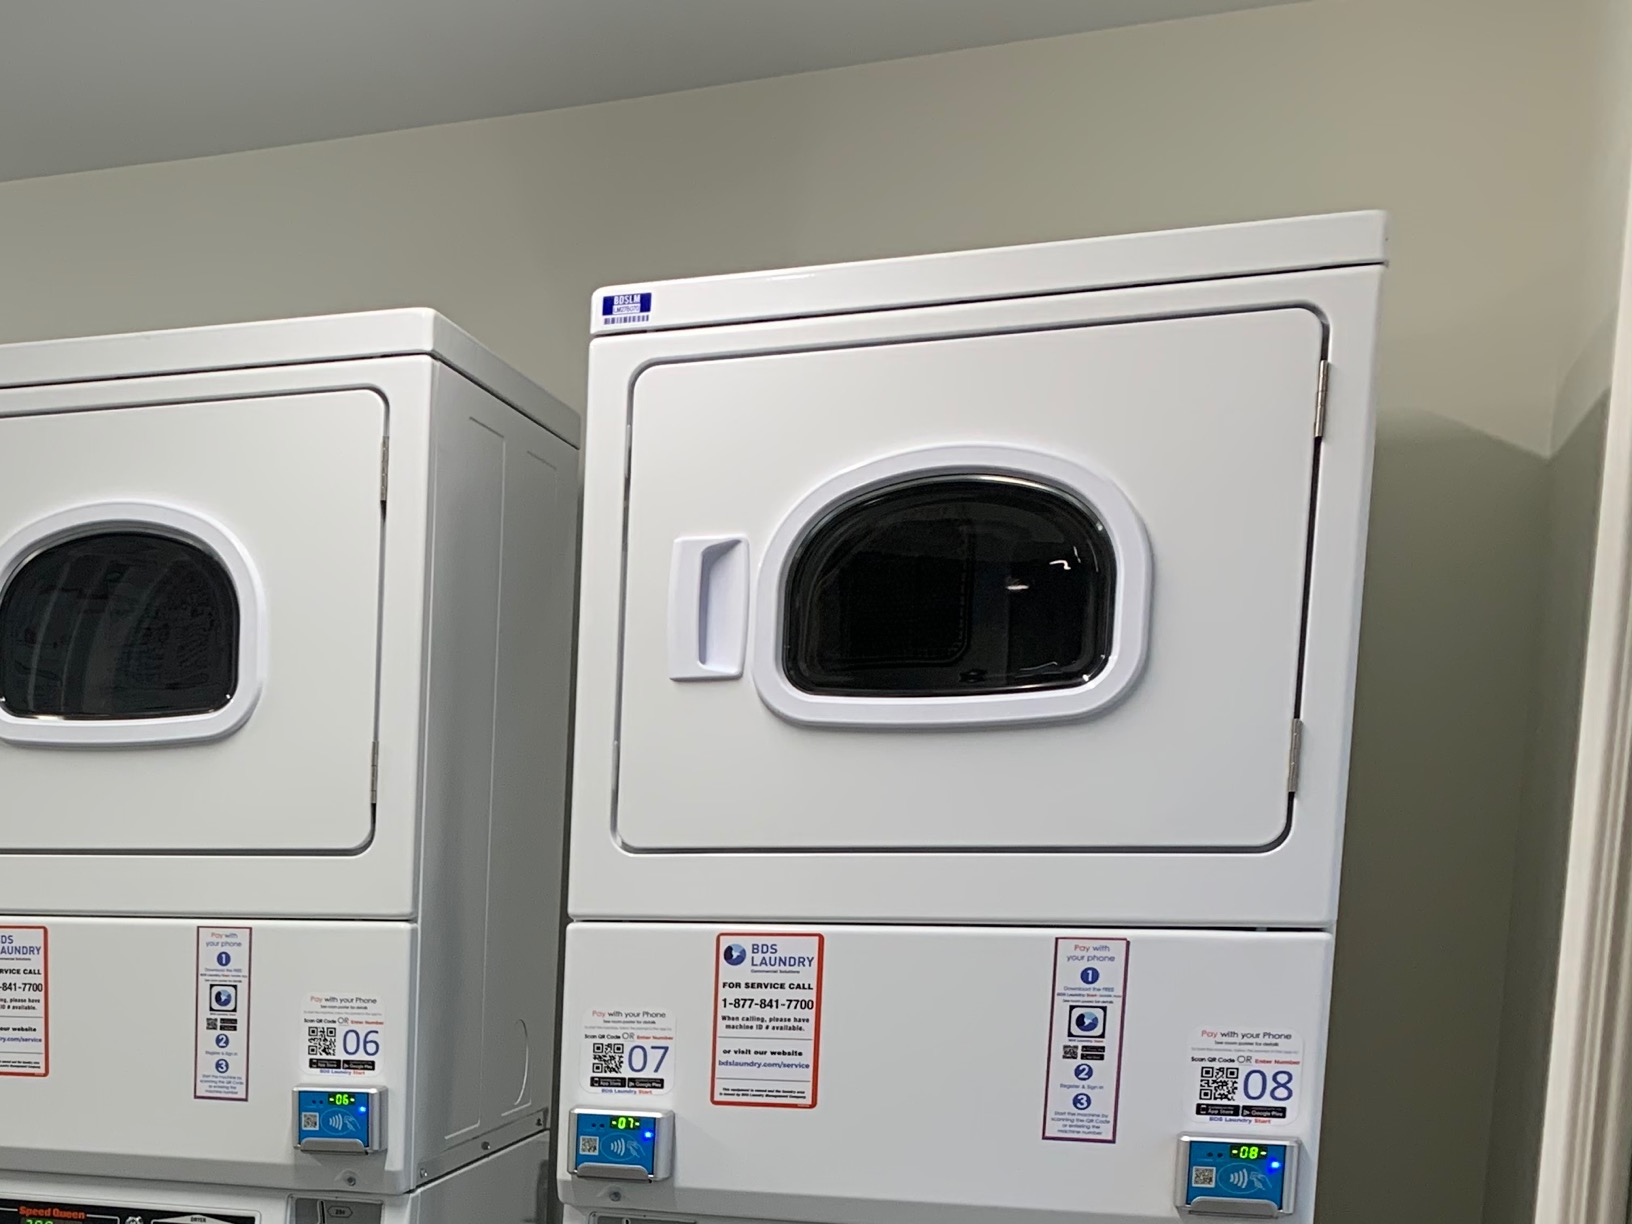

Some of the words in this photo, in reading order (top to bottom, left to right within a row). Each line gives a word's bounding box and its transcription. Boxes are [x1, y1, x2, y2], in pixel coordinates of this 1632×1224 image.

[752, 944, 778, 954] BDS
[1073, 944, 1090, 952] Pay
[751, 956, 814, 967] LAUNDRY
[1087, 969, 1093, 982] 1
[744, 982, 786, 990] SERVICE
[722, 998, 814, 1010] 1-877-841-7700
[592, 1010, 606, 1018] Pay
[741, 1015, 767, 1023] calling,
[218, 1034, 227, 1047] 2
[622, 1031, 635, 1040] OR
[1201, 1030, 1218, 1038] Pay
[1219, 1030, 1239, 1038] with
[1240, 1032, 1260, 1040] your
[1262, 1031, 1292, 1040] Phone
[342, 1029, 380, 1056] 06
[628, 1045, 669, 1073] 07
[718, 1060, 810, 1069] bdslaundry.com/service
[1237, 1055, 1253, 1063] OR
[218, 1060, 227, 1072] 3
[1078, 1064, 1089, 1079] 2
[1243, 1069, 1293, 1101] 08
[1076, 1094, 1088, 1109] 3
[19, 1206, 51, 1216] Speed
[52, 1208, 85, 1219] Queen
